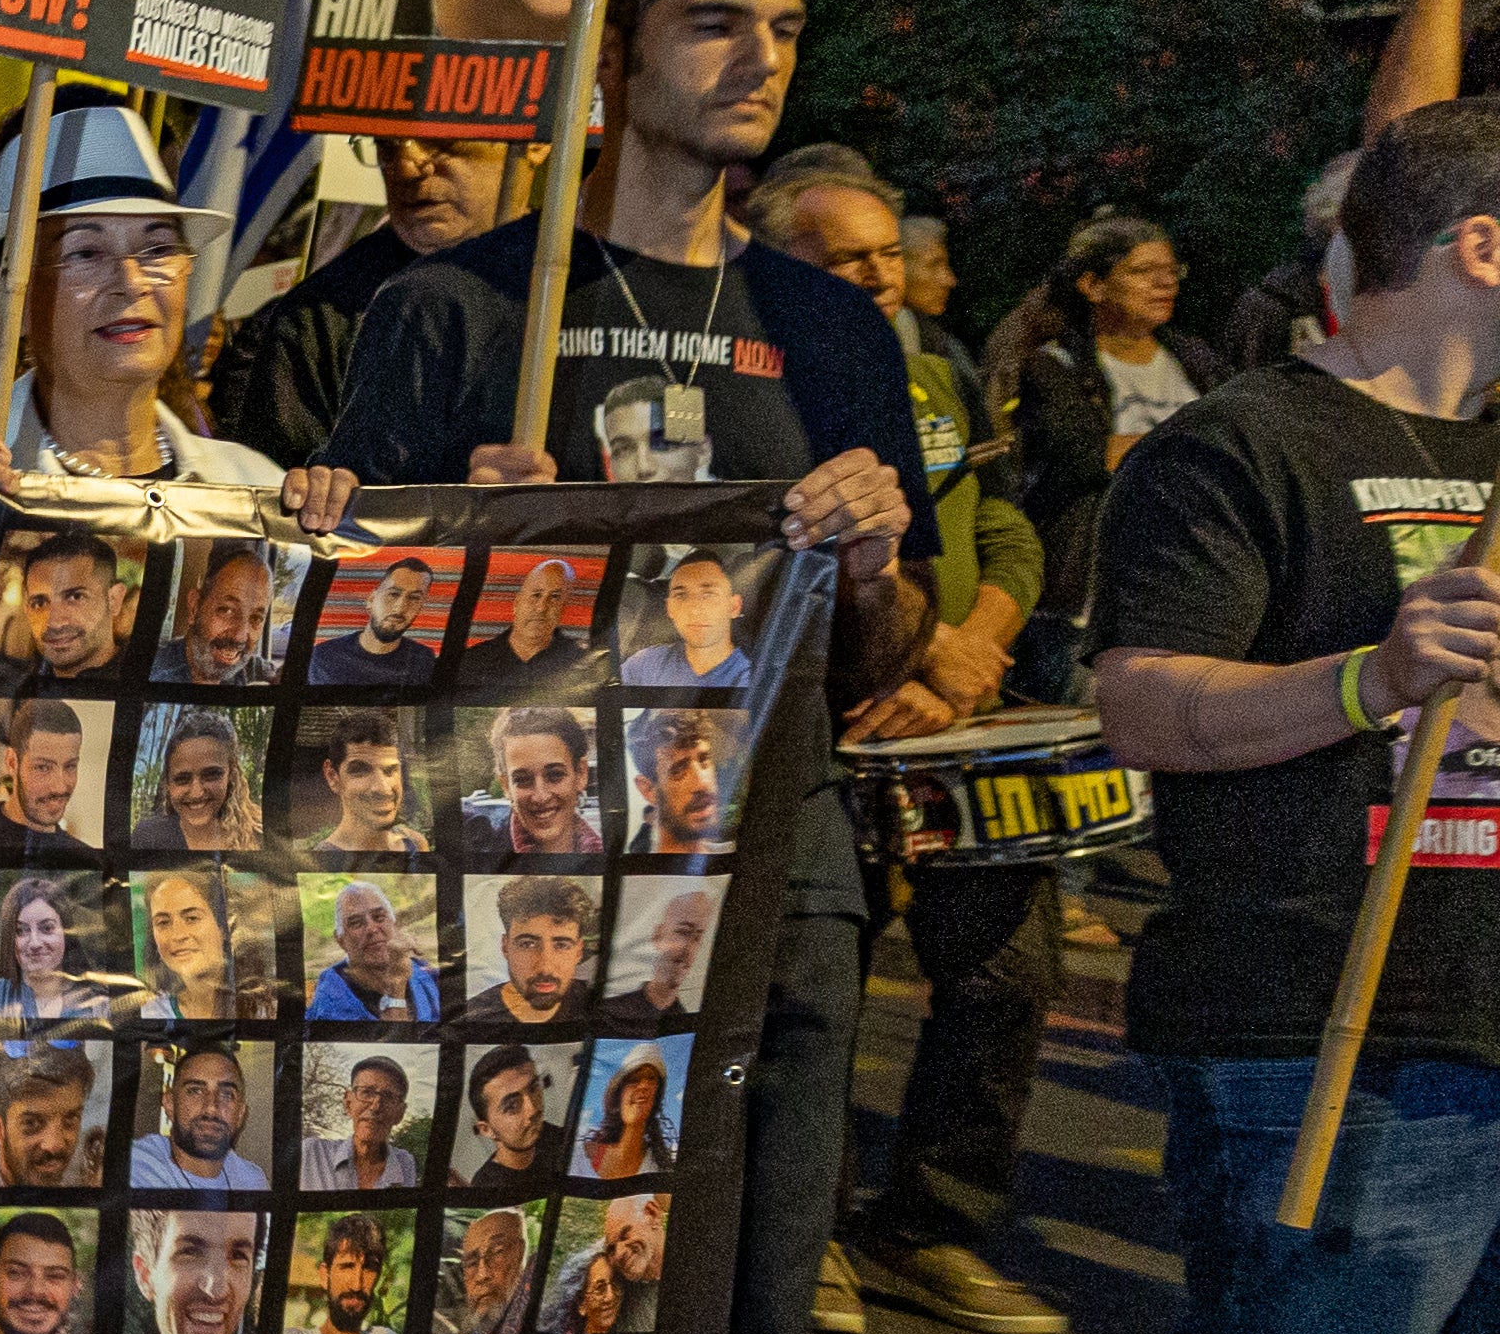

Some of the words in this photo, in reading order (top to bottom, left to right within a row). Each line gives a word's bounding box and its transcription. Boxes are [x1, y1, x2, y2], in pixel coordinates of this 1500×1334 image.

[130, 17, 209, 68] FAMILIES
[207, 35, 271, 82] FORUM
[301, 48, 424, 110] HOME
[424, 51, 549, 117] NOW!
[557, 327, 604, 357] RING
[608, 328, 668, 360] THEM
[671, 331, 732, 366] HOME
[1419, 818, 1498, 856] RING
